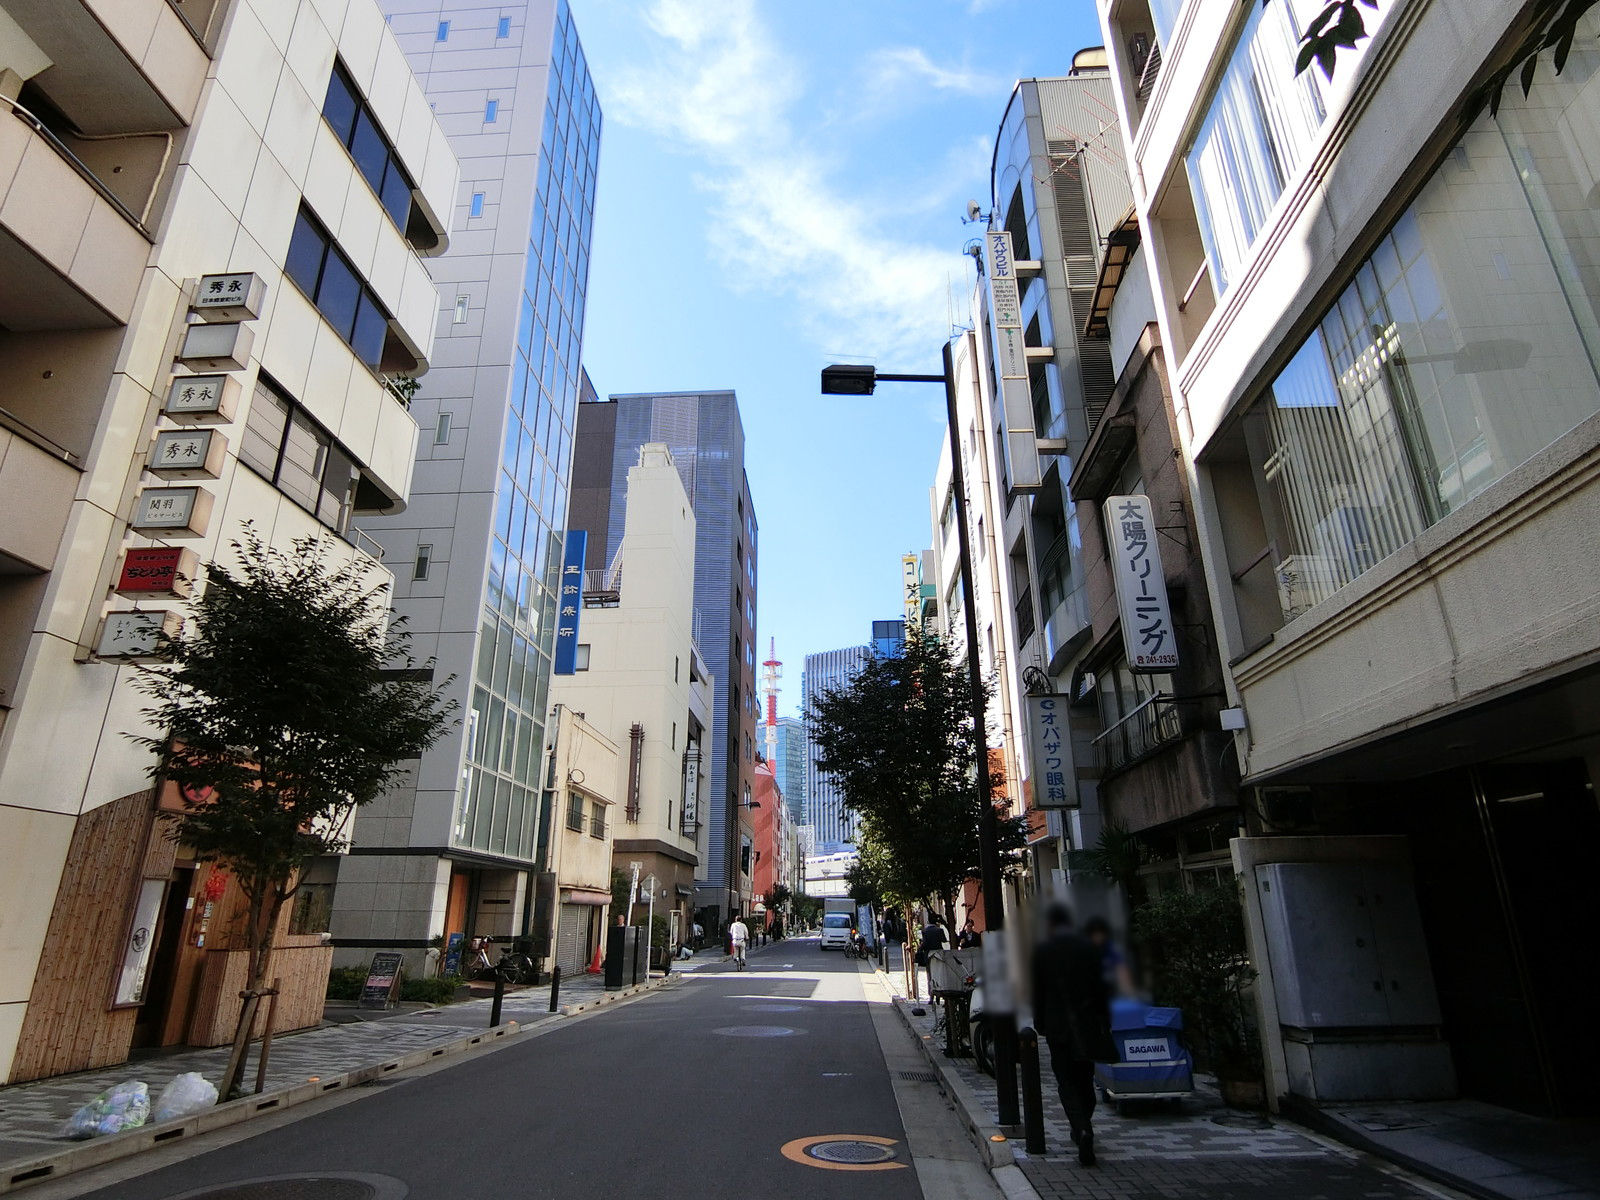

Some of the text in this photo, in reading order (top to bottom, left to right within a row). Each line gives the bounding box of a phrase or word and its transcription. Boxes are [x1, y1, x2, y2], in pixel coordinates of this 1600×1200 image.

[208, 280, 243, 293] 秀永
[181, 386, 213, 403] 秀永
[165, 442, 199, 459] 秀永
[1118, 500, 1168, 656] 太陽クリーニング
[1145, 654, 1176, 664] 241-2936
[1129, 1044, 1166, 1054] SAGAWA
